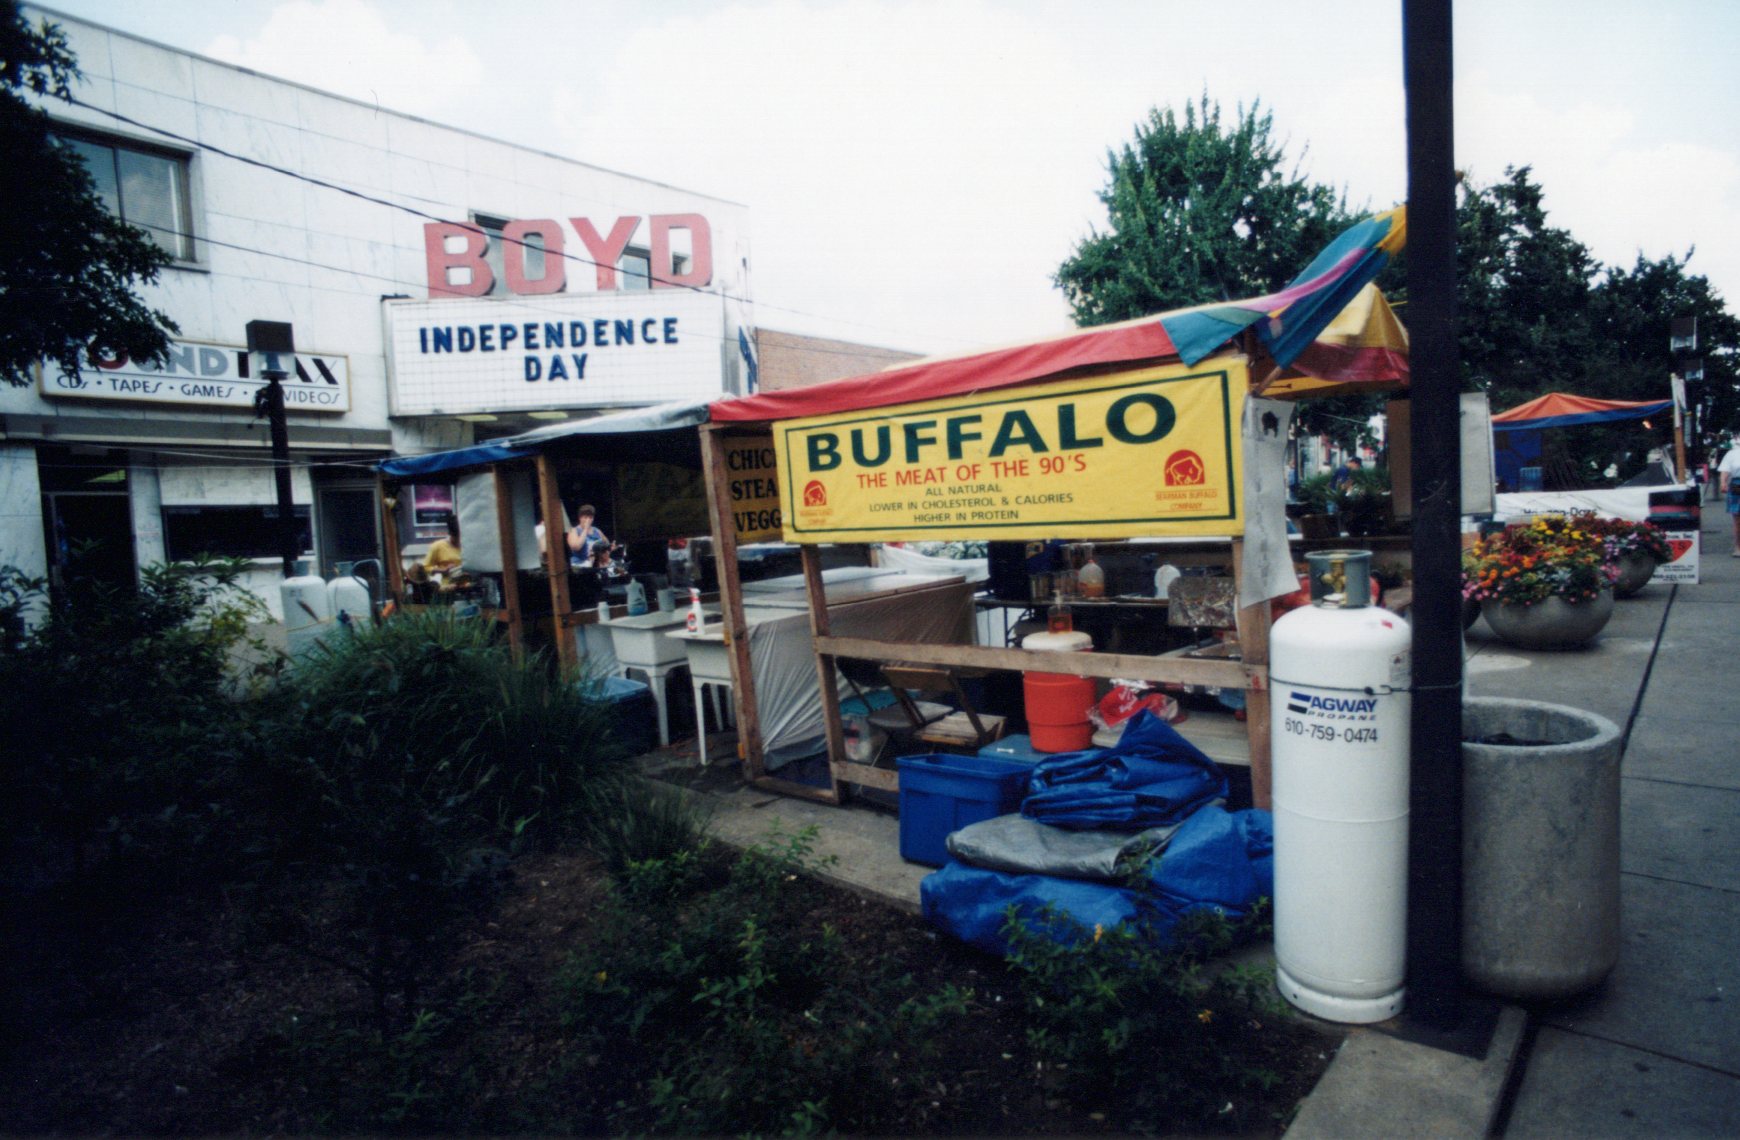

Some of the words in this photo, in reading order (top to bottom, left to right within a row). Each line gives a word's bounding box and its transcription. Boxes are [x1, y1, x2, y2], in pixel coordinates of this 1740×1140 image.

[423, 213, 714, 298] BOYD
[419, 317, 679, 353] INDEPENDENCE
[523, 353, 588, 382] DAY
[109, 378, 162, 394] TAPES
[181, 383, 235, 398] GAMES
[283, 390, 341, 405] VIDEOS
[806, 392, 1177, 472] BUFFALO
[728, 448, 777, 471] CHIC
[856, 472, 888, 489] THE
[895, 467, 948, 486] MEAT
[956, 464, 982, 482] OF
[990, 459, 1030, 479] THE
[1039, 453, 1088, 475] 90'S
[869, 501, 904, 513] LOWER
[907, 501, 918, 510] IN
[921, 497, 996, 510] CHOLESTEROL
[1001, 496, 1009, 506] &
[1015, 492, 1074, 506] CALORIES
[925, 486, 944, 497] ALL
[947, 483, 1003, 496] NATURAL
[913, 512, 951, 523] HIGHER
[955, 511, 967, 521] IN
[971, 510, 1020, 521] PROTEIN
[1308, 710, 1376, 720] PROPANE
[1310, 696, 1378, 713] AGWAY
[1285, 717, 1378, 743] 610-759-0474
